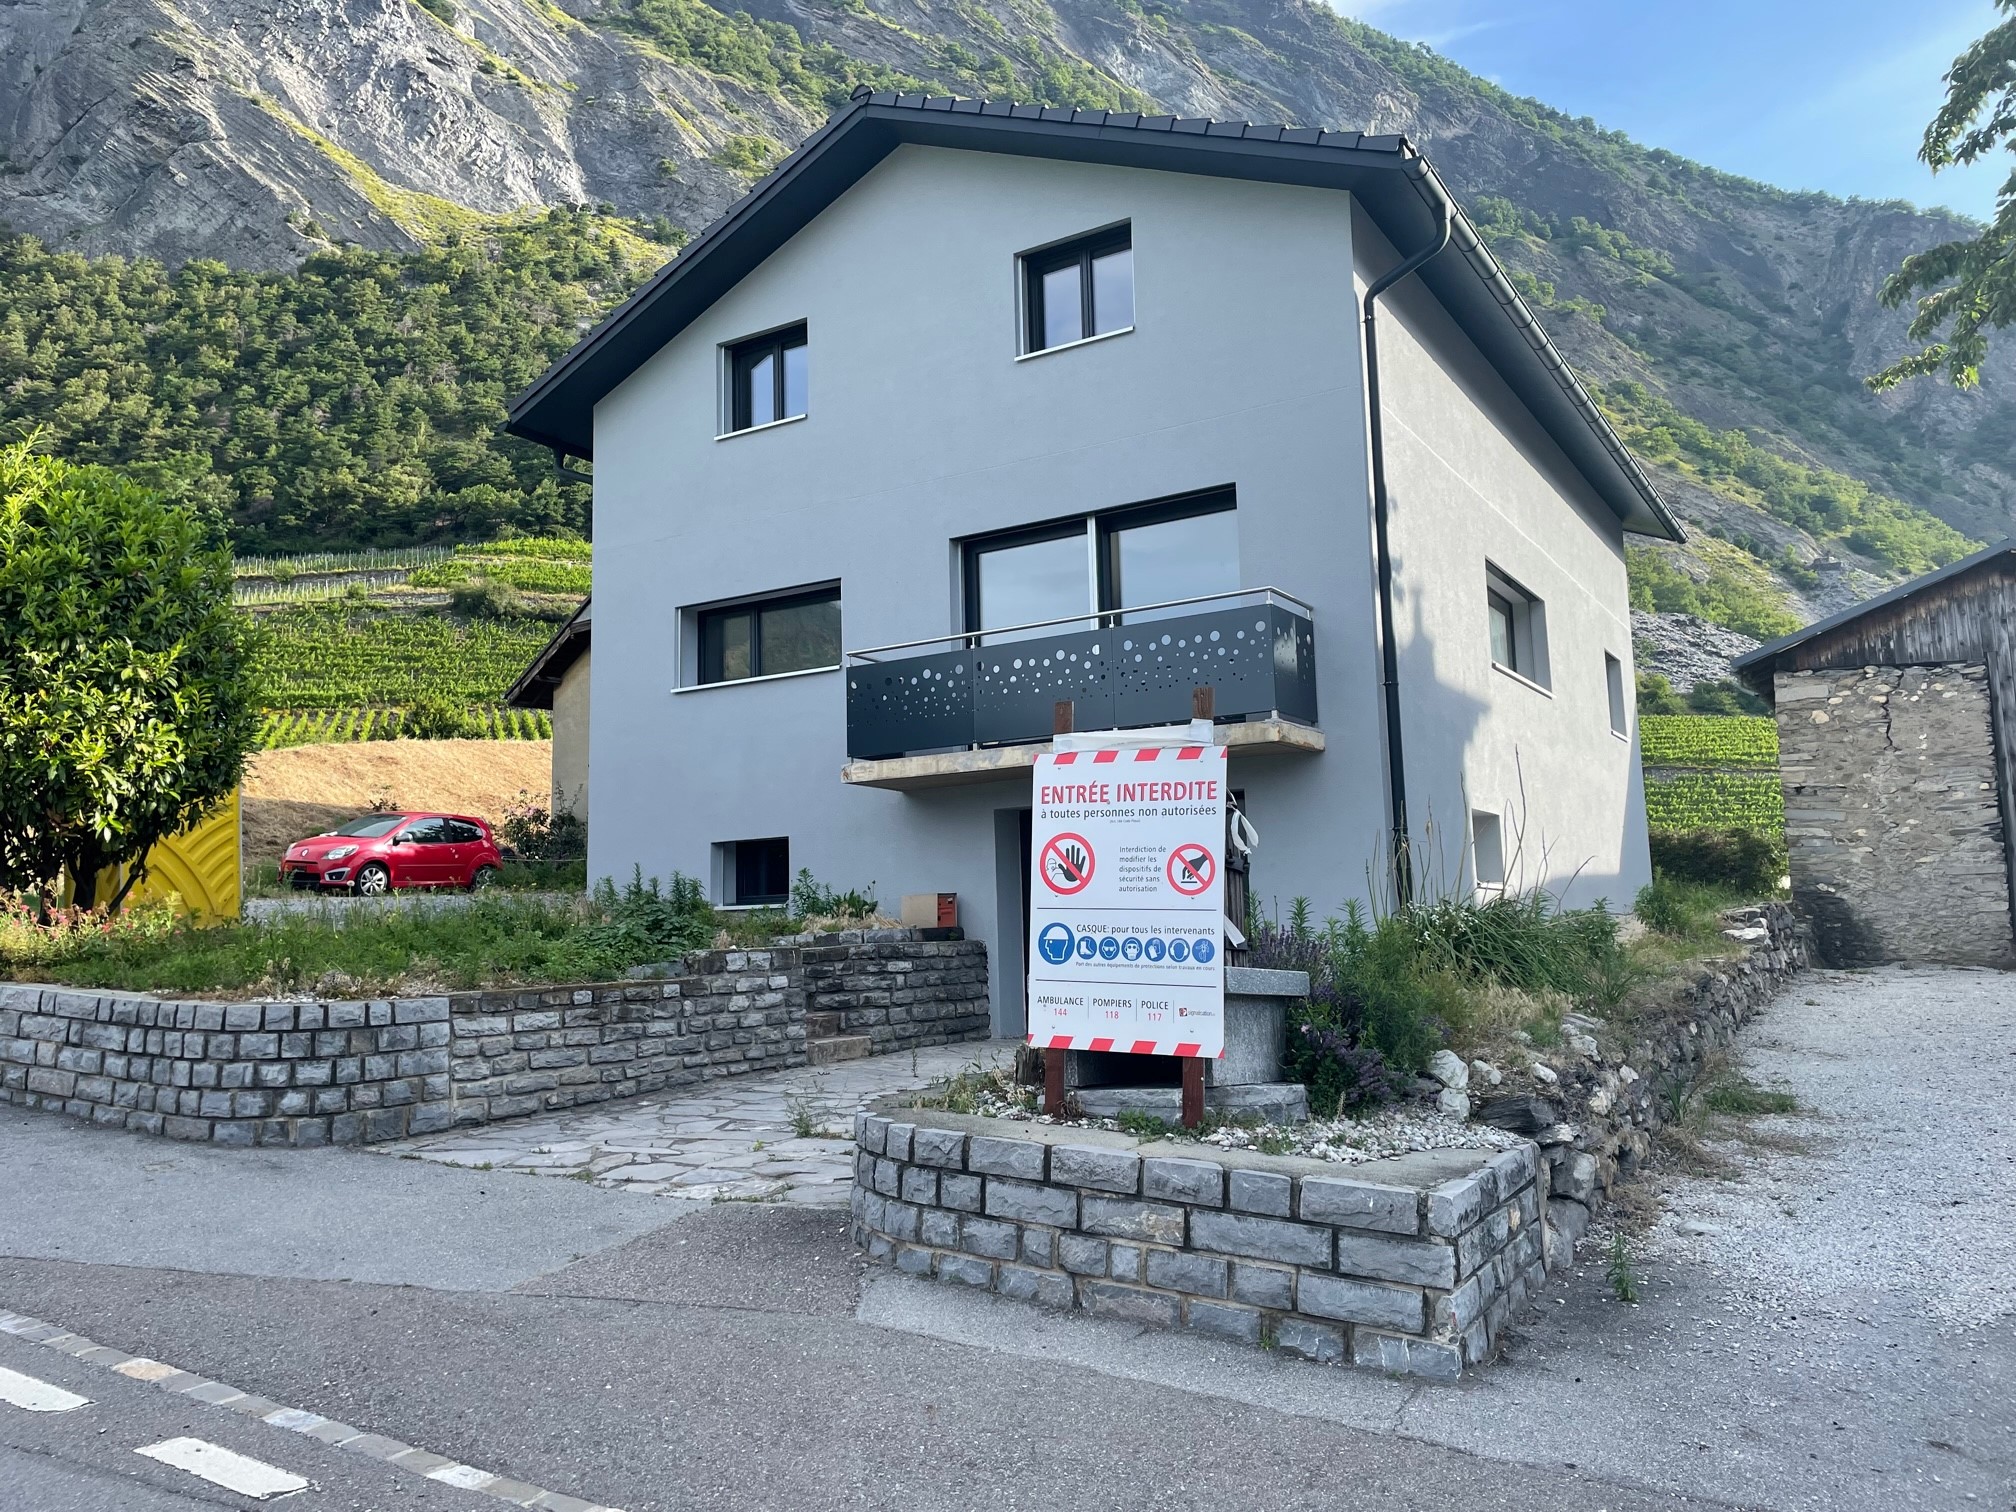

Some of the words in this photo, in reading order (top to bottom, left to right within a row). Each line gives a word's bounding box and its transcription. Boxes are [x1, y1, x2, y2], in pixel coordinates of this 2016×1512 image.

[1041, 781, 1110, 804] ENTRÉE
[1116, 780, 1218, 802] INTERDITE
[1041, 808, 1047, 819] à
[1050, 808, 1081, 819] toutes
[1083, 808, 1135, 820] personnes
[1139, 807, 1158, 817] non
[1161, 804, 1217, 817] autorisées
[1119, 845, 1157, 853] Interdiction
[1158, 845, 1167, 853] de
[1119, 855, 1146, 863] modifier
[1147, 855, 1157, 863] les
[1119, 865, 1152, 873] dispositifs
[1153, 865, 1162, 873] de
[1119, 875, 1144, 883] sécurité
[1119, 885, 1158, 893] autorisation
[1111, 926, 1130, 935] pour
[1131, 926, 1149, 934] tous
[1150, 925, 1162, 934] les
[1164, 925, 1215, 936] intervenants
[1037, 996, 1084, 1006] AMBULANCE
[1092, 998, 1132, 1008] POMPIERS
[1141, 1000, 1169, 1010] POLICE
[1054, 1008, 1067, 1016] 144
[1105, 1011, 1119, 1020] 118
[1148, 1012, 1162, 1022] 117
